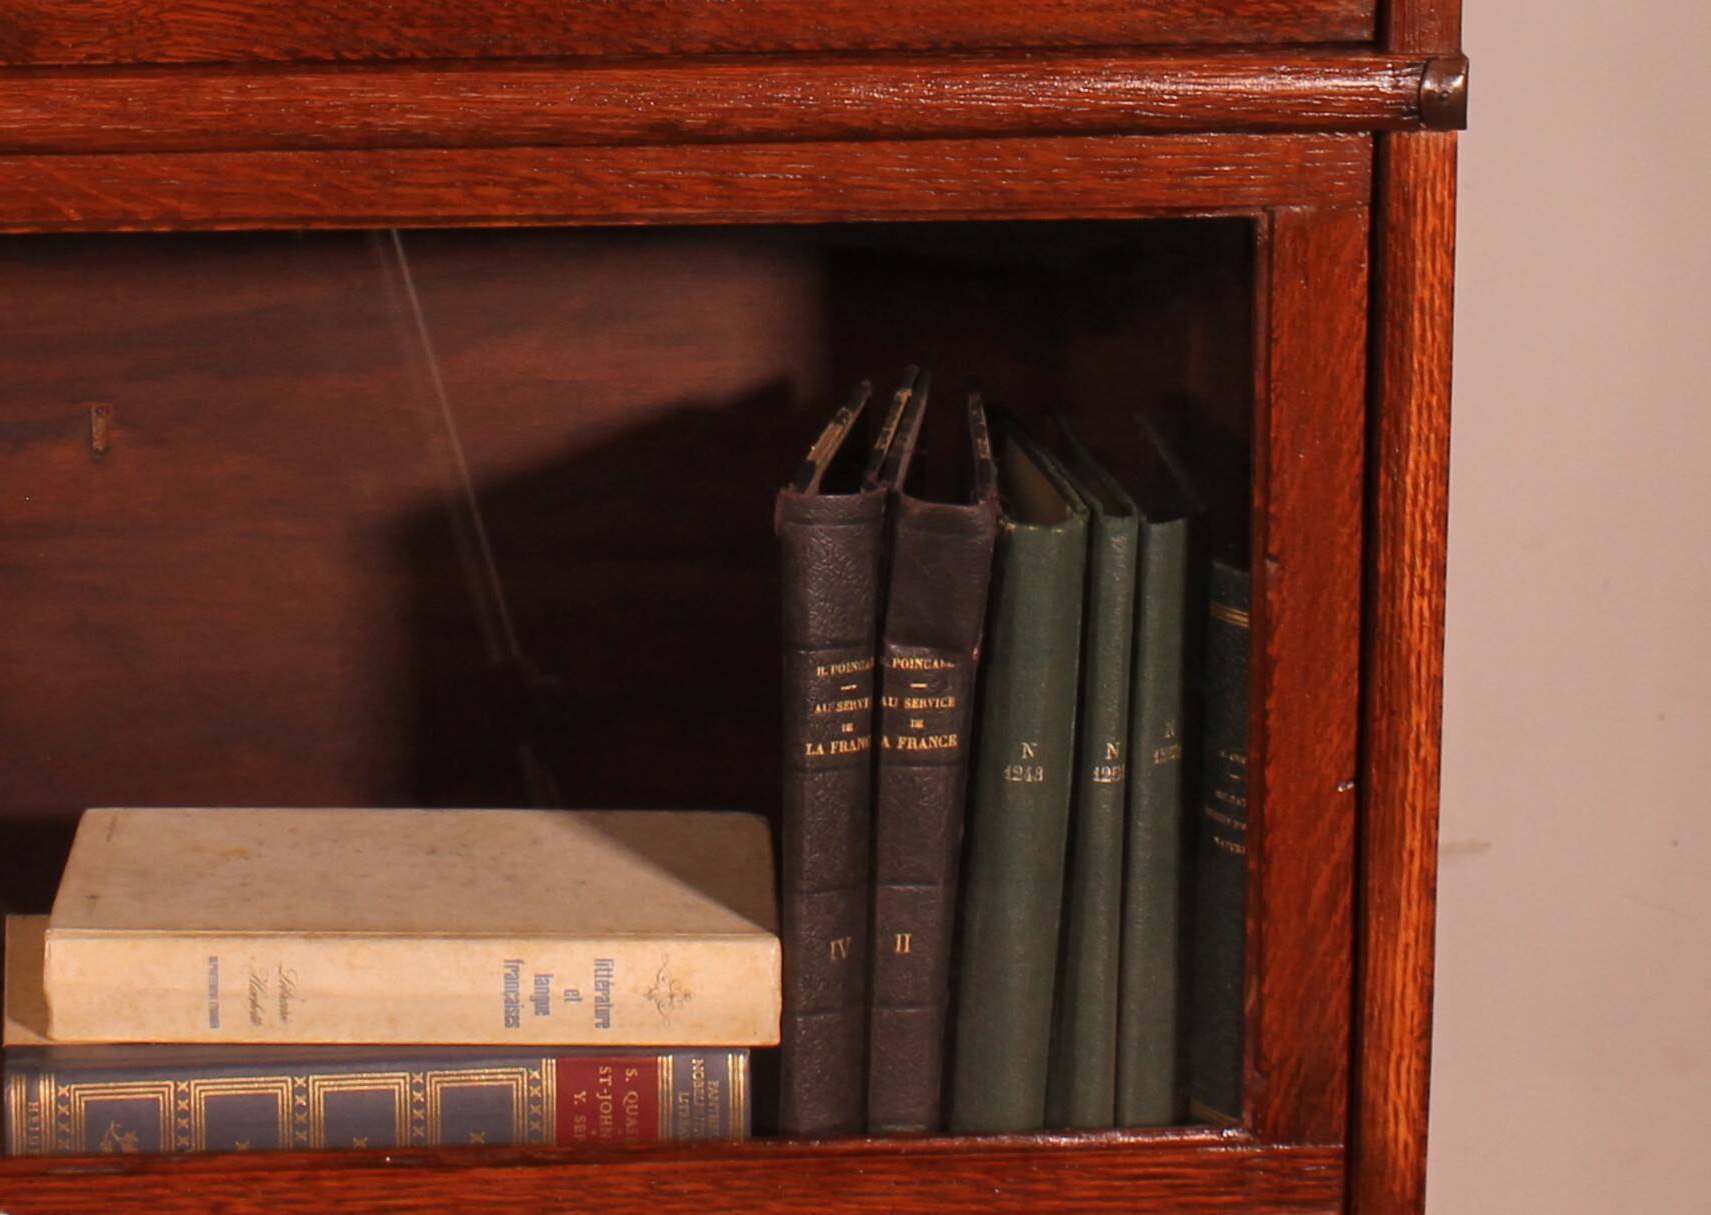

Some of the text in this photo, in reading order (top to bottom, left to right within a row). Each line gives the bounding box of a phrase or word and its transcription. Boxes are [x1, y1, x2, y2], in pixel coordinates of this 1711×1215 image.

[835, 698, 871, 713] SERVI
[904, 696, 957, 710] SERVICE
[806, 742, 825, 756] LA
[896, 734, 958, 751] FRANCE
[1021, 741, 1038, 760] N
[1104, 741, 1121, 760] N
[829, 936, 853, 961] IV
[895, 933, 913, 954] II
[529, 974, 554, 1016] langue
[564, 988, 582, 1004] et
[624, 1067, 638, 1082] S.
